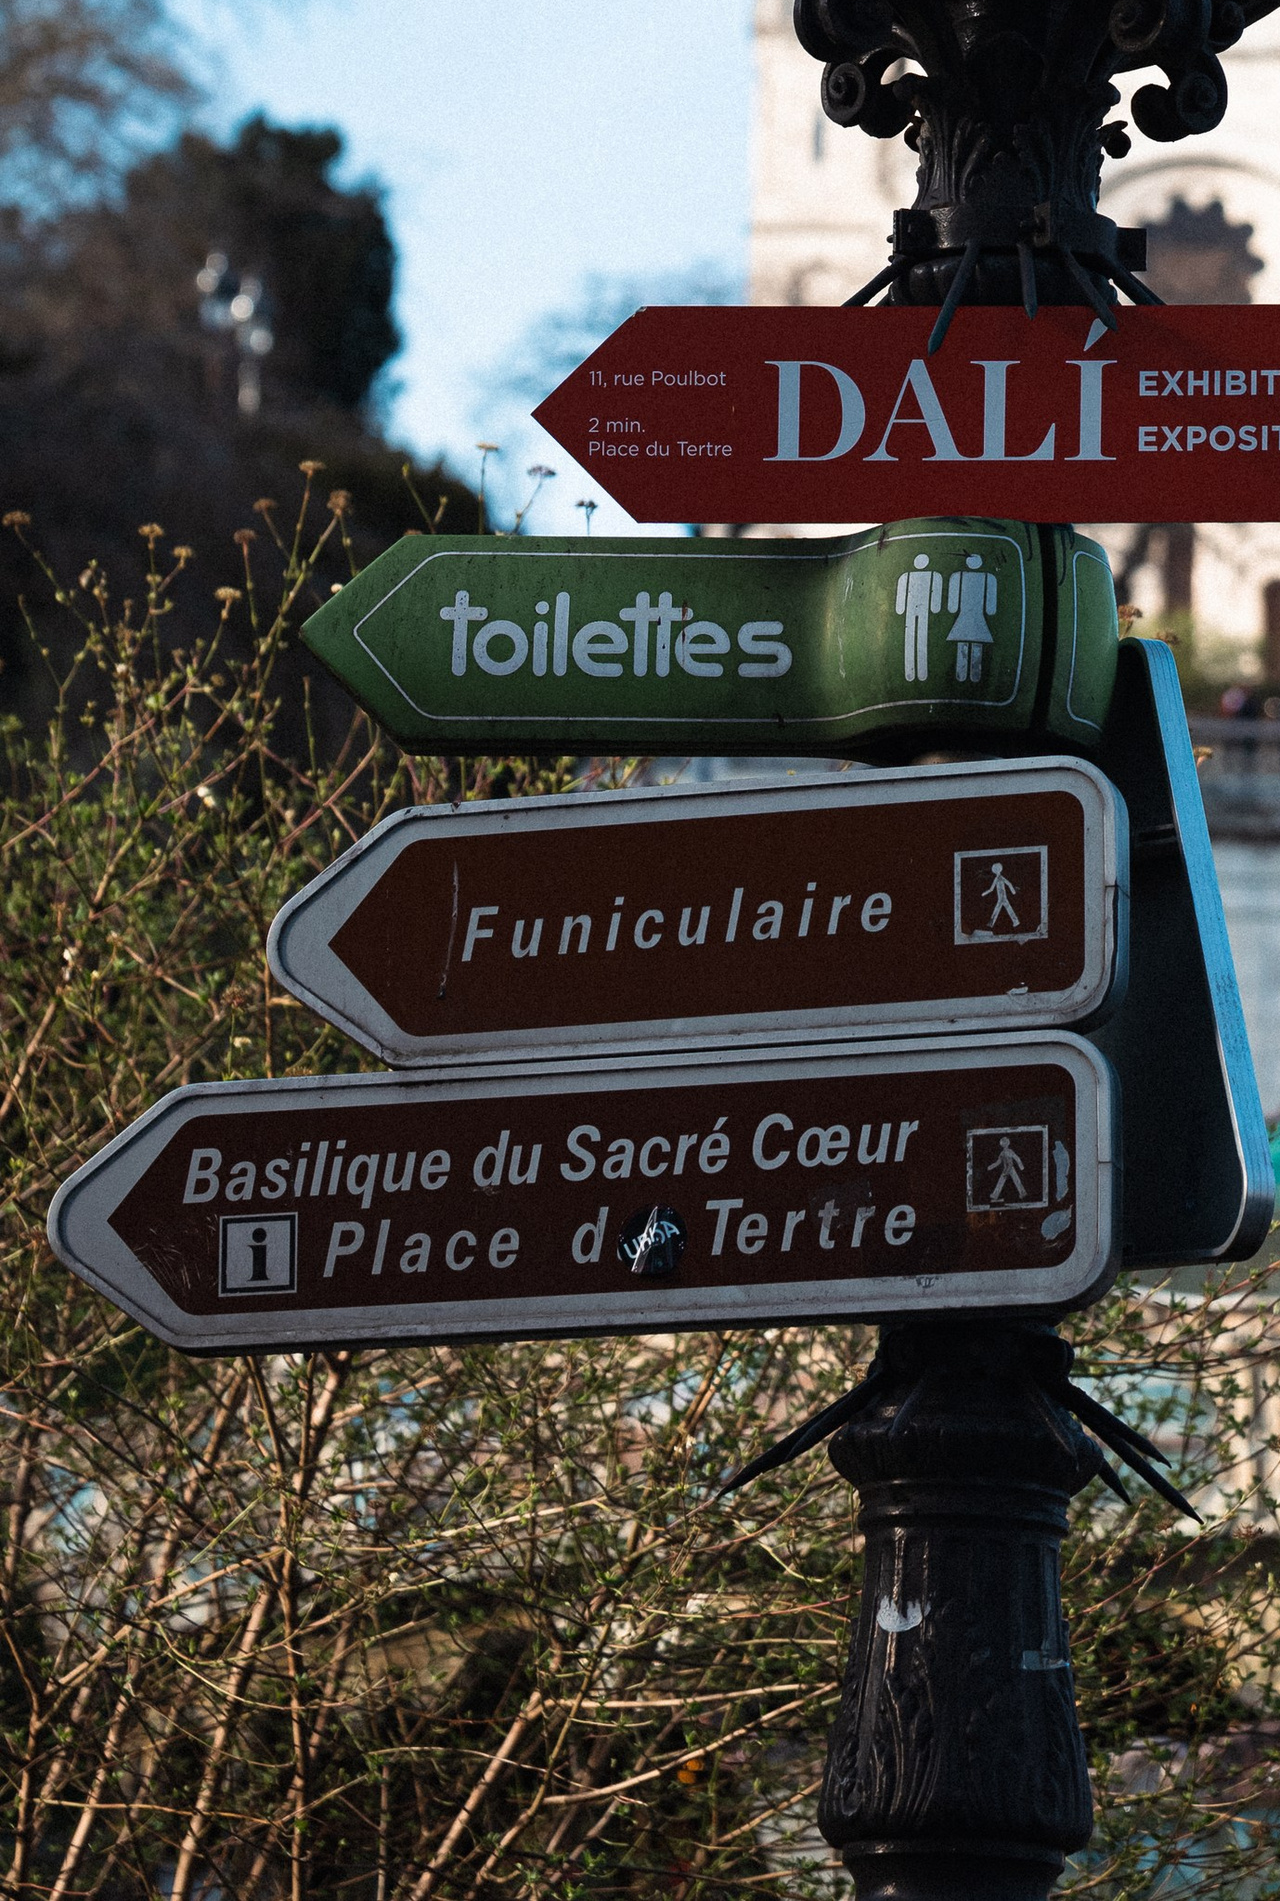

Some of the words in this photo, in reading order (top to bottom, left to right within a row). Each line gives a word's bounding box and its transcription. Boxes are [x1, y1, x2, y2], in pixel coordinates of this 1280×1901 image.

[588, 370, 608, 388] 11,
[613, 373, 645, 387] rue
[650, 370, 727, 387] Poulbot
[762, 317, 1119, 462] DALÍ
[588, 417, 600, 434] 2
[605, 417, 646, 434] min.
[588, 441, 640, 457] Place
[645, 441, 670, 457] du
[676, 441, 733, 457] Tertre
[439, 589, 793, 678] toilettes
[461, 881, 893, 962] Funiculaire
[181, 1138, 452, 1210] Basilique
[472, 1129, 543, 1188] du
[559, 1116, 731, 1183] Sacré
[751, 1112, 920, 1172] Cœur
[322, 1218, 521, 1279] Place
[704, 1198, 917, 1257] Tertre
